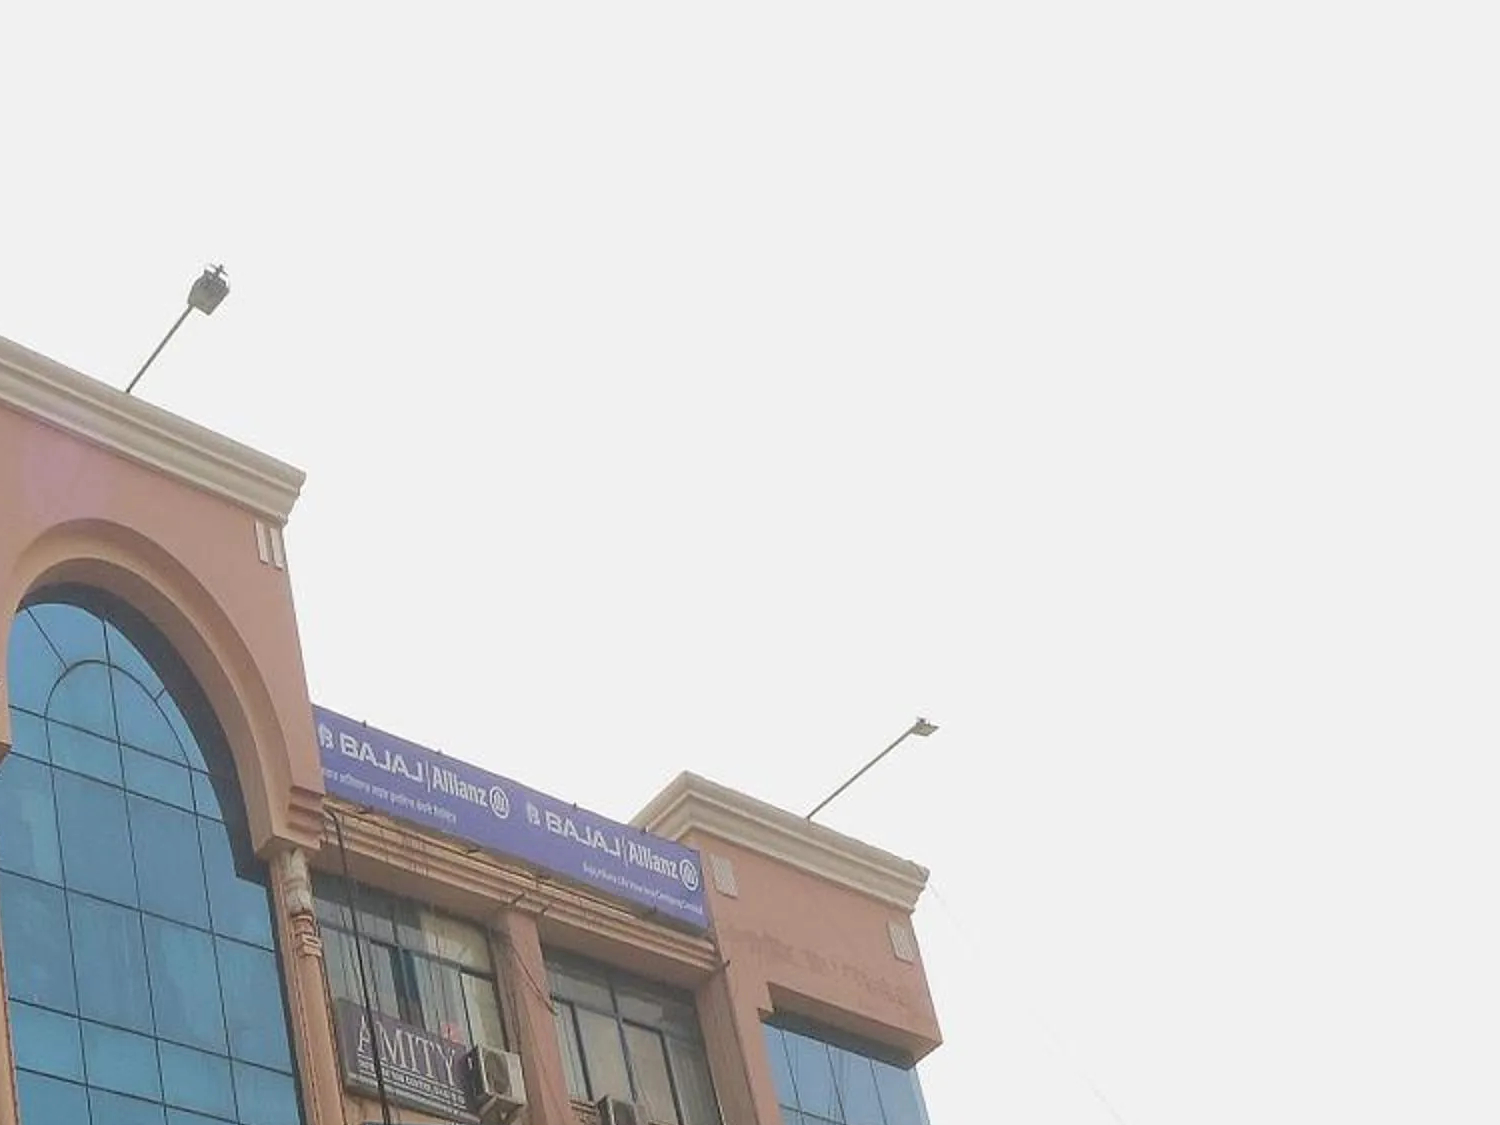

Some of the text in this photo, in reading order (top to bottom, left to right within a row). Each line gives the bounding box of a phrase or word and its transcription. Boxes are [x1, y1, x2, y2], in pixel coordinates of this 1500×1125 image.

[340, 733, 423, 783] BAJAJ
[432, 766, 488, 807] Allianz
[546, 810, 680, 880] BAJAJ Allianz
[358, 1015, 456, 1088] AMITY
